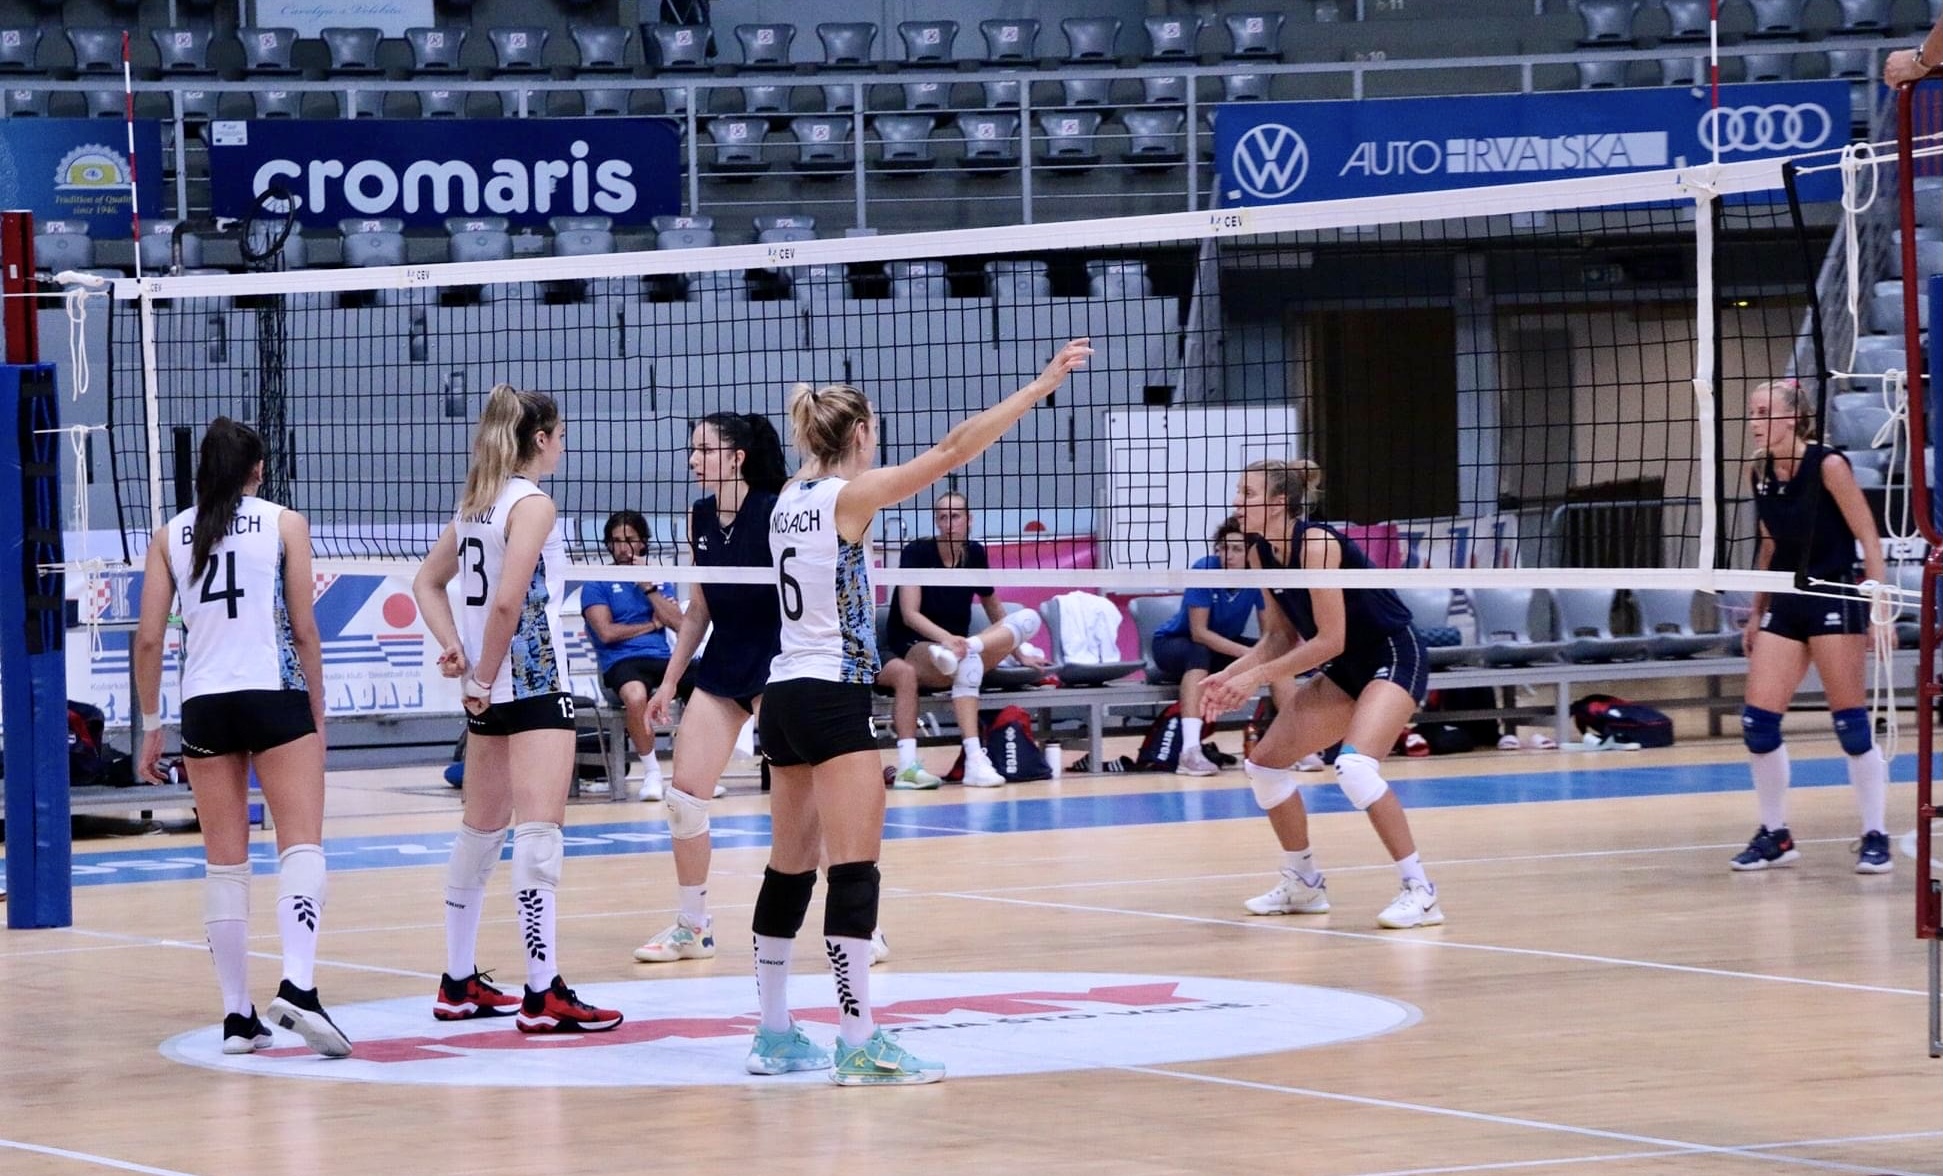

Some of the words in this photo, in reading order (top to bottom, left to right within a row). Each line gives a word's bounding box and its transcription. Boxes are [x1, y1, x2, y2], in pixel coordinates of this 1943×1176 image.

[252, 139, 638, 214] cromaris
[1339, 140, 1442, 176] AUTO
[1446, 134, 1633, 174] HRVATSKA
[779, 247, 795, 260] CEV
[200, 550, 245, 619] 4
[458, 536, 488, 607] 13
[779, 547, 804, 622] 6
[557, 697, 575, 719] 13
